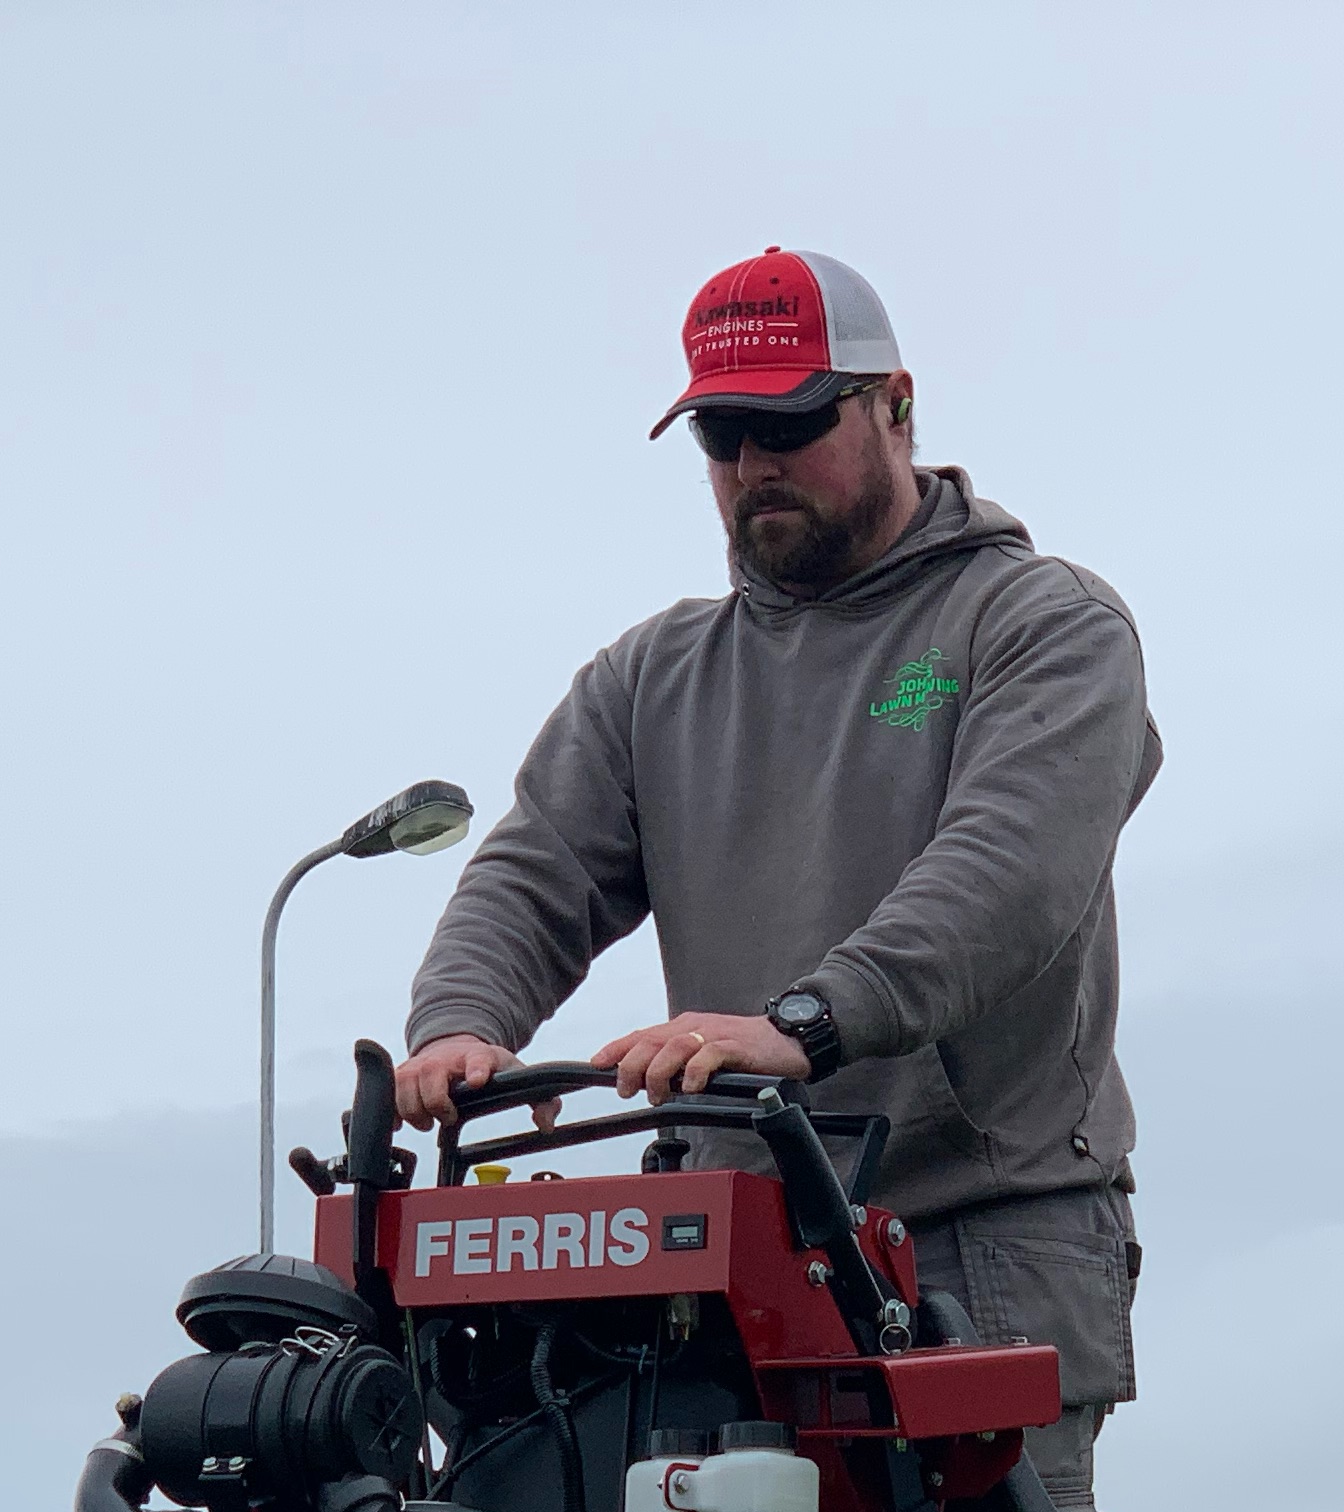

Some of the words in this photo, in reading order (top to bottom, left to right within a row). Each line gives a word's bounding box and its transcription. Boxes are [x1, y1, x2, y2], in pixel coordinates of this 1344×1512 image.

[708, 320, 764, 337] ENGINES
[706, 336, 760, 352] TRUSTED
[768, 336, 799, 347] ONE
[870, 695, 913, 716] LAWN
[414, 1207, 650, 1278] FERRIS
